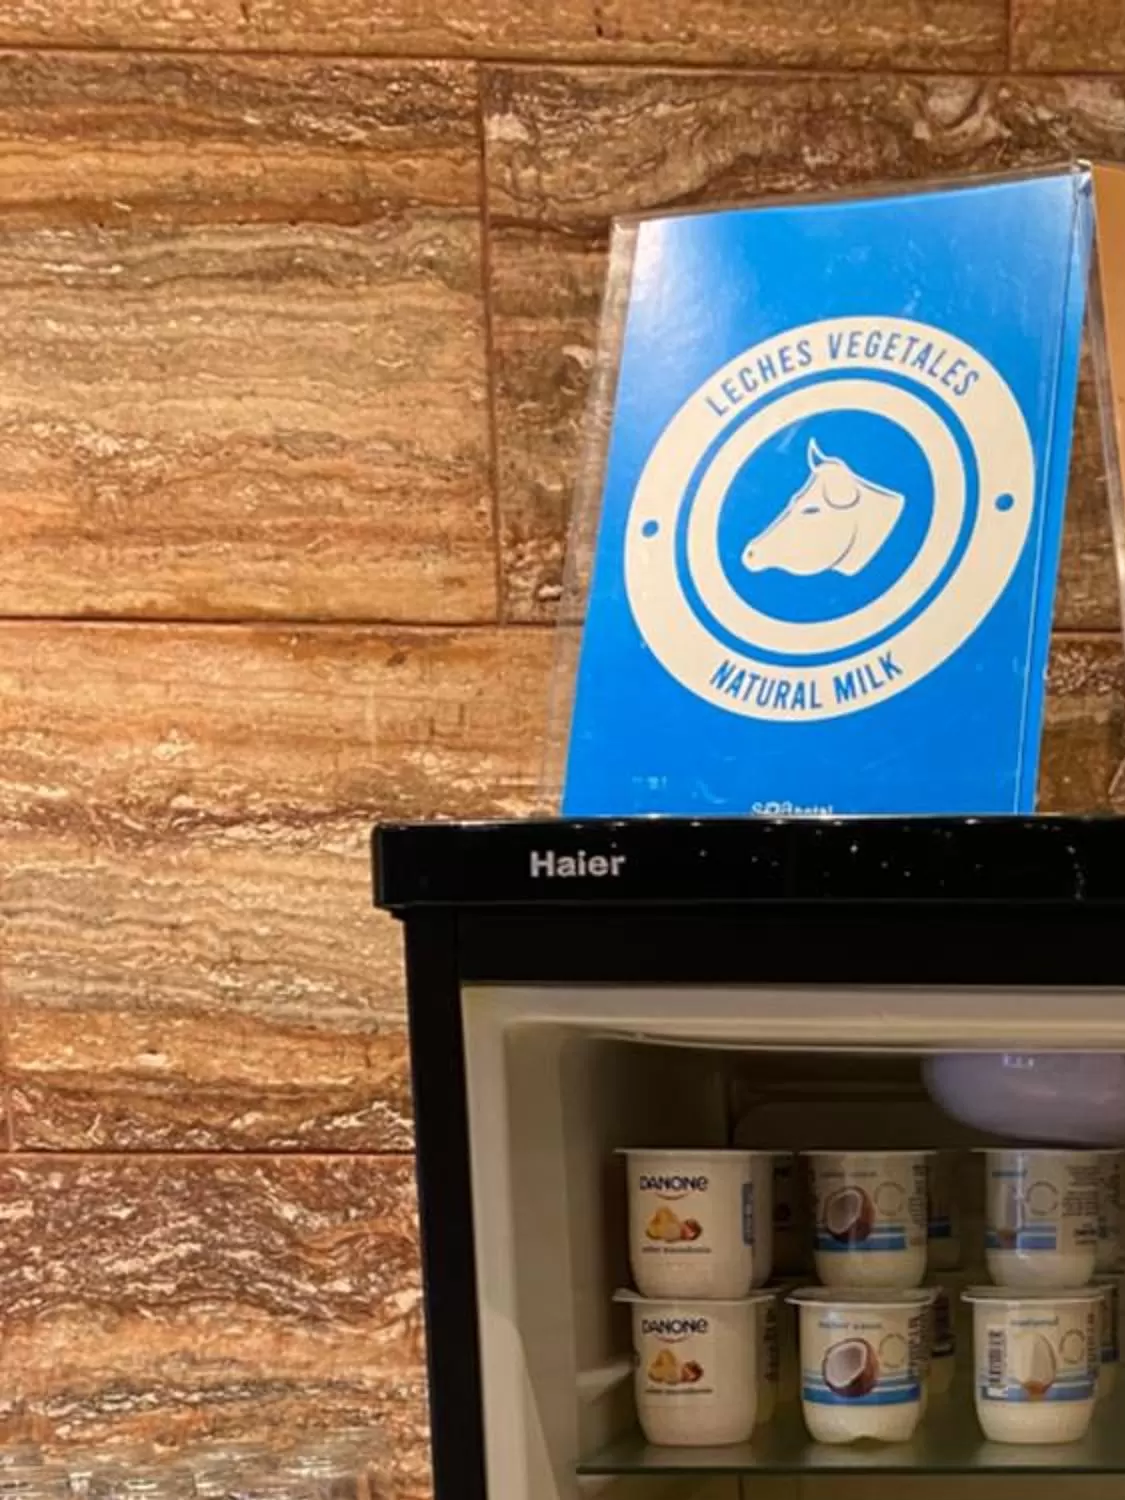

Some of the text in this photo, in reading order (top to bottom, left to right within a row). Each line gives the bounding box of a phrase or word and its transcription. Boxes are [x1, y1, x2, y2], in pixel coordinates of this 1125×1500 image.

[705, 331, 980, 418] LECHES VEGETALES
[710, 652, 903, 711] NATURAL MILK
[530, 849, 627, 878] Haier
[639, 1175, 708, 1192] DANONE
[641, 1319, 708, 1334] DANONE
